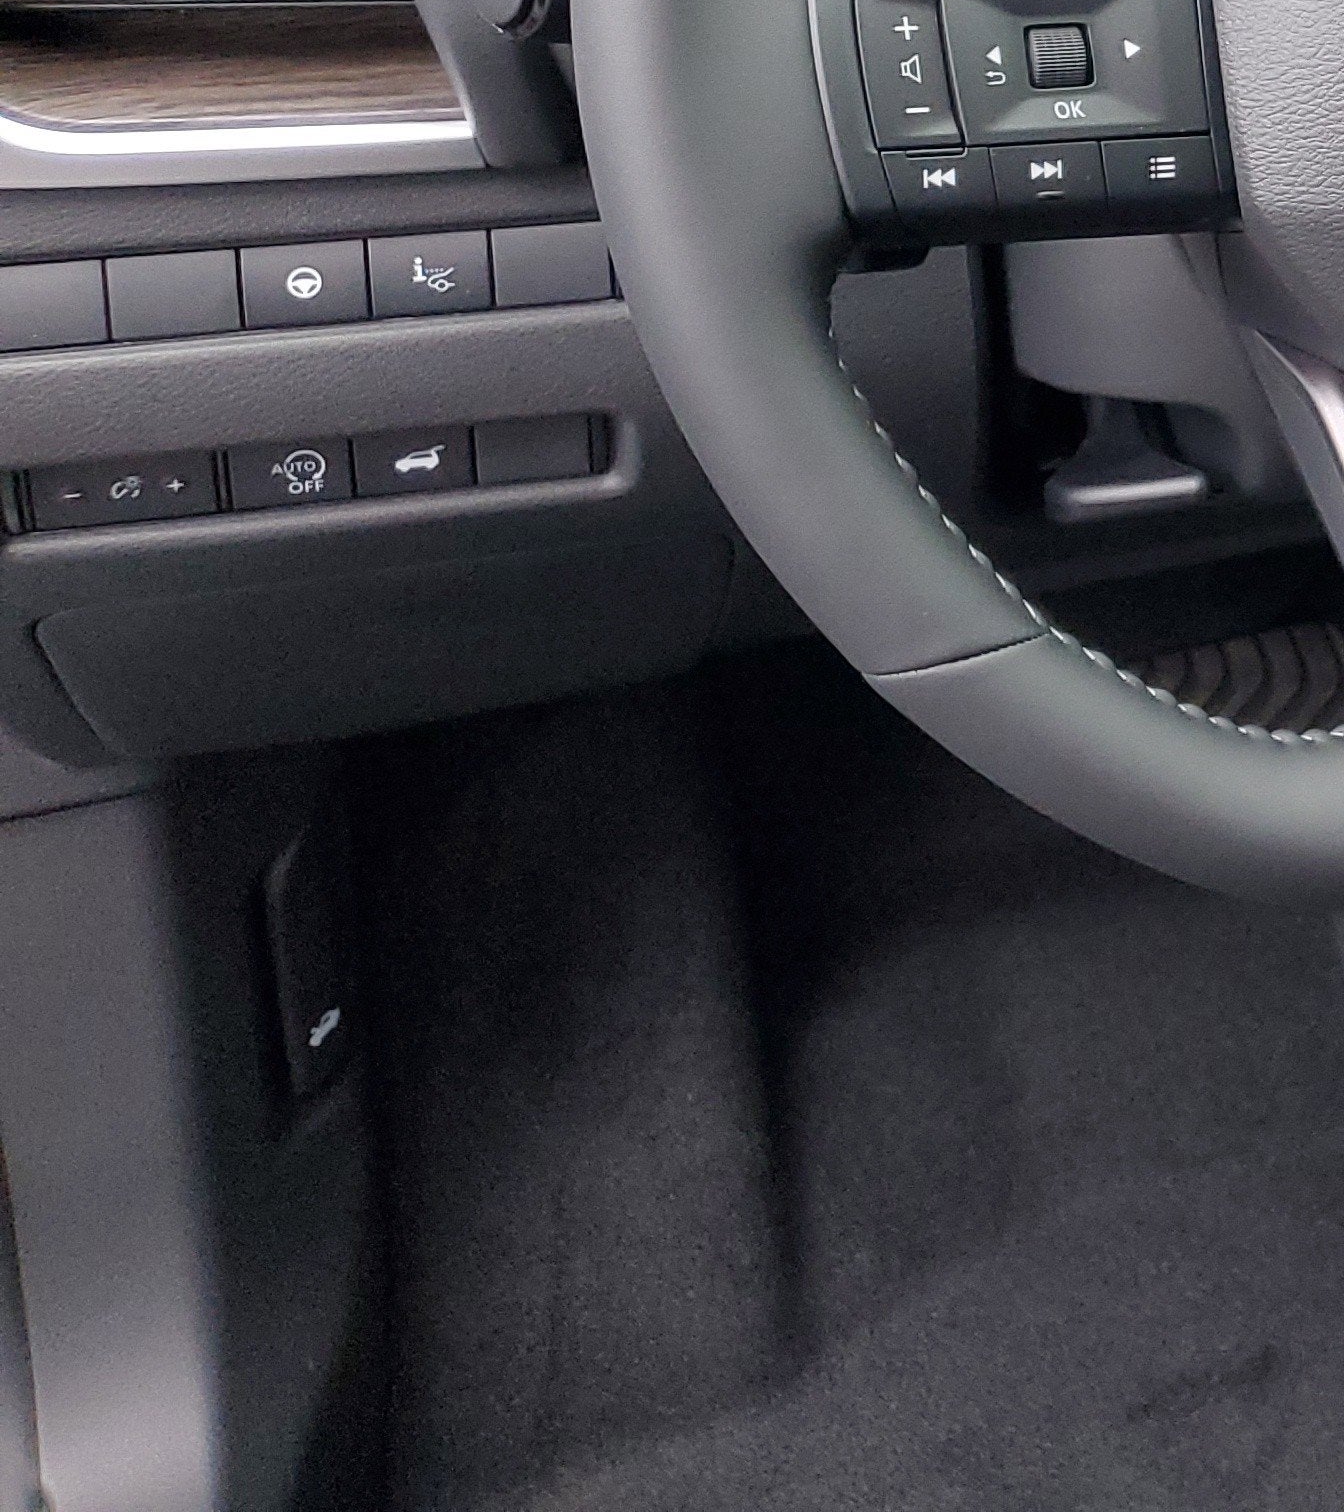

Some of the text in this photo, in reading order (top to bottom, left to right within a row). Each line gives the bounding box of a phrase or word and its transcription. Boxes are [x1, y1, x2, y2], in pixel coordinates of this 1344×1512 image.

[1053, 99, 1087, 120] OK
[270, 460, 317, 477] AUTO
[288, 478, 325, 495] OFF
